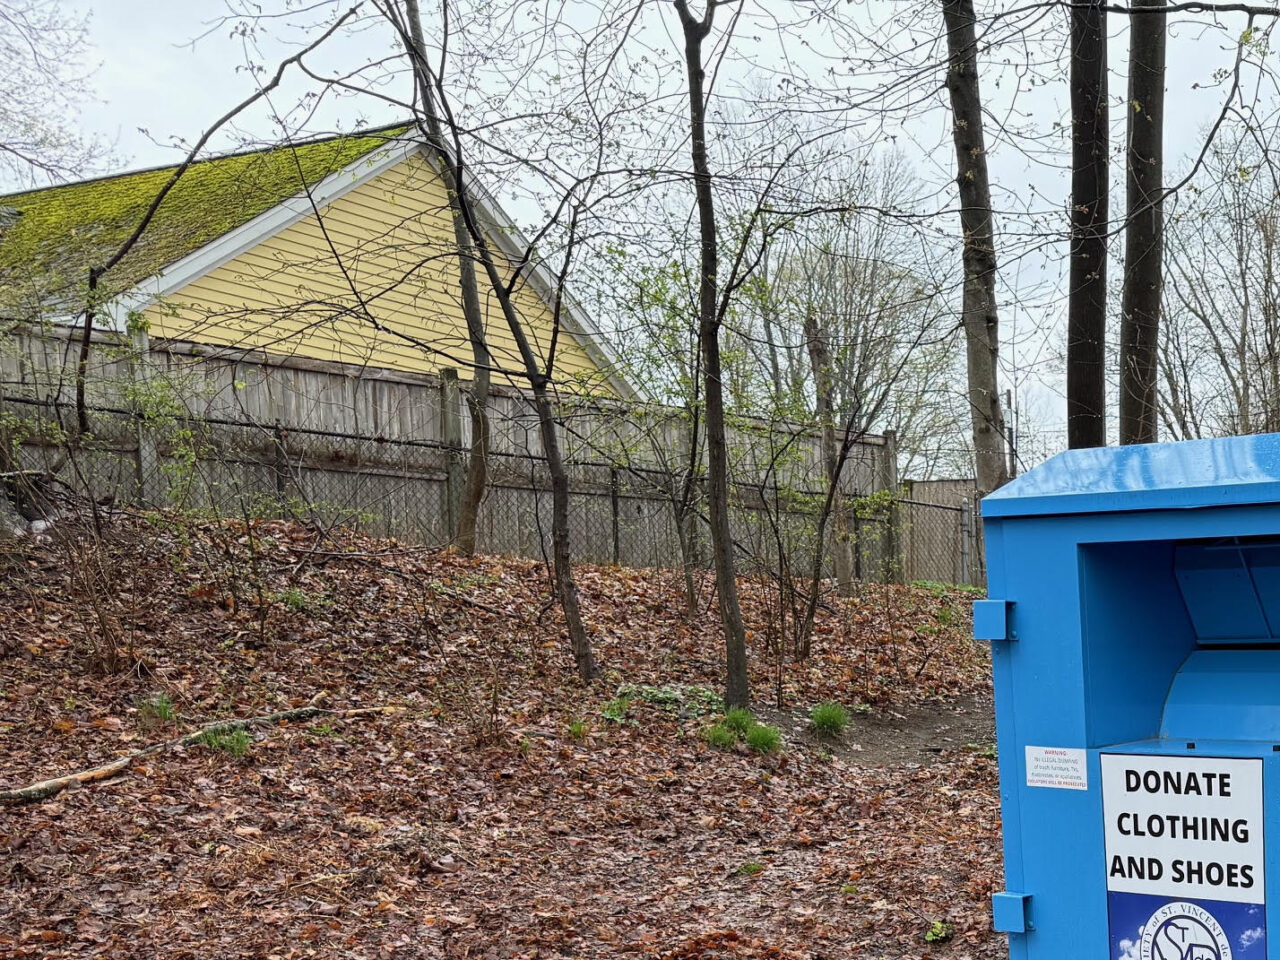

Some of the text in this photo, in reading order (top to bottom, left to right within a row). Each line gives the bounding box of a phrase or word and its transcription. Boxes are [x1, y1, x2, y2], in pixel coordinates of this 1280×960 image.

[1125, 769, 1232, 797] DONATE
[1117, 812, 1250, 843] CLOTHING
[1110, 855, 1254, 888] AND SHOES
[1152, 917, 1160, 928] of
[1161, 905, 1177, 918] ST.
[1180, 904, 1223, 937] VINCENT
[1220, 944, 1229, 957] de
